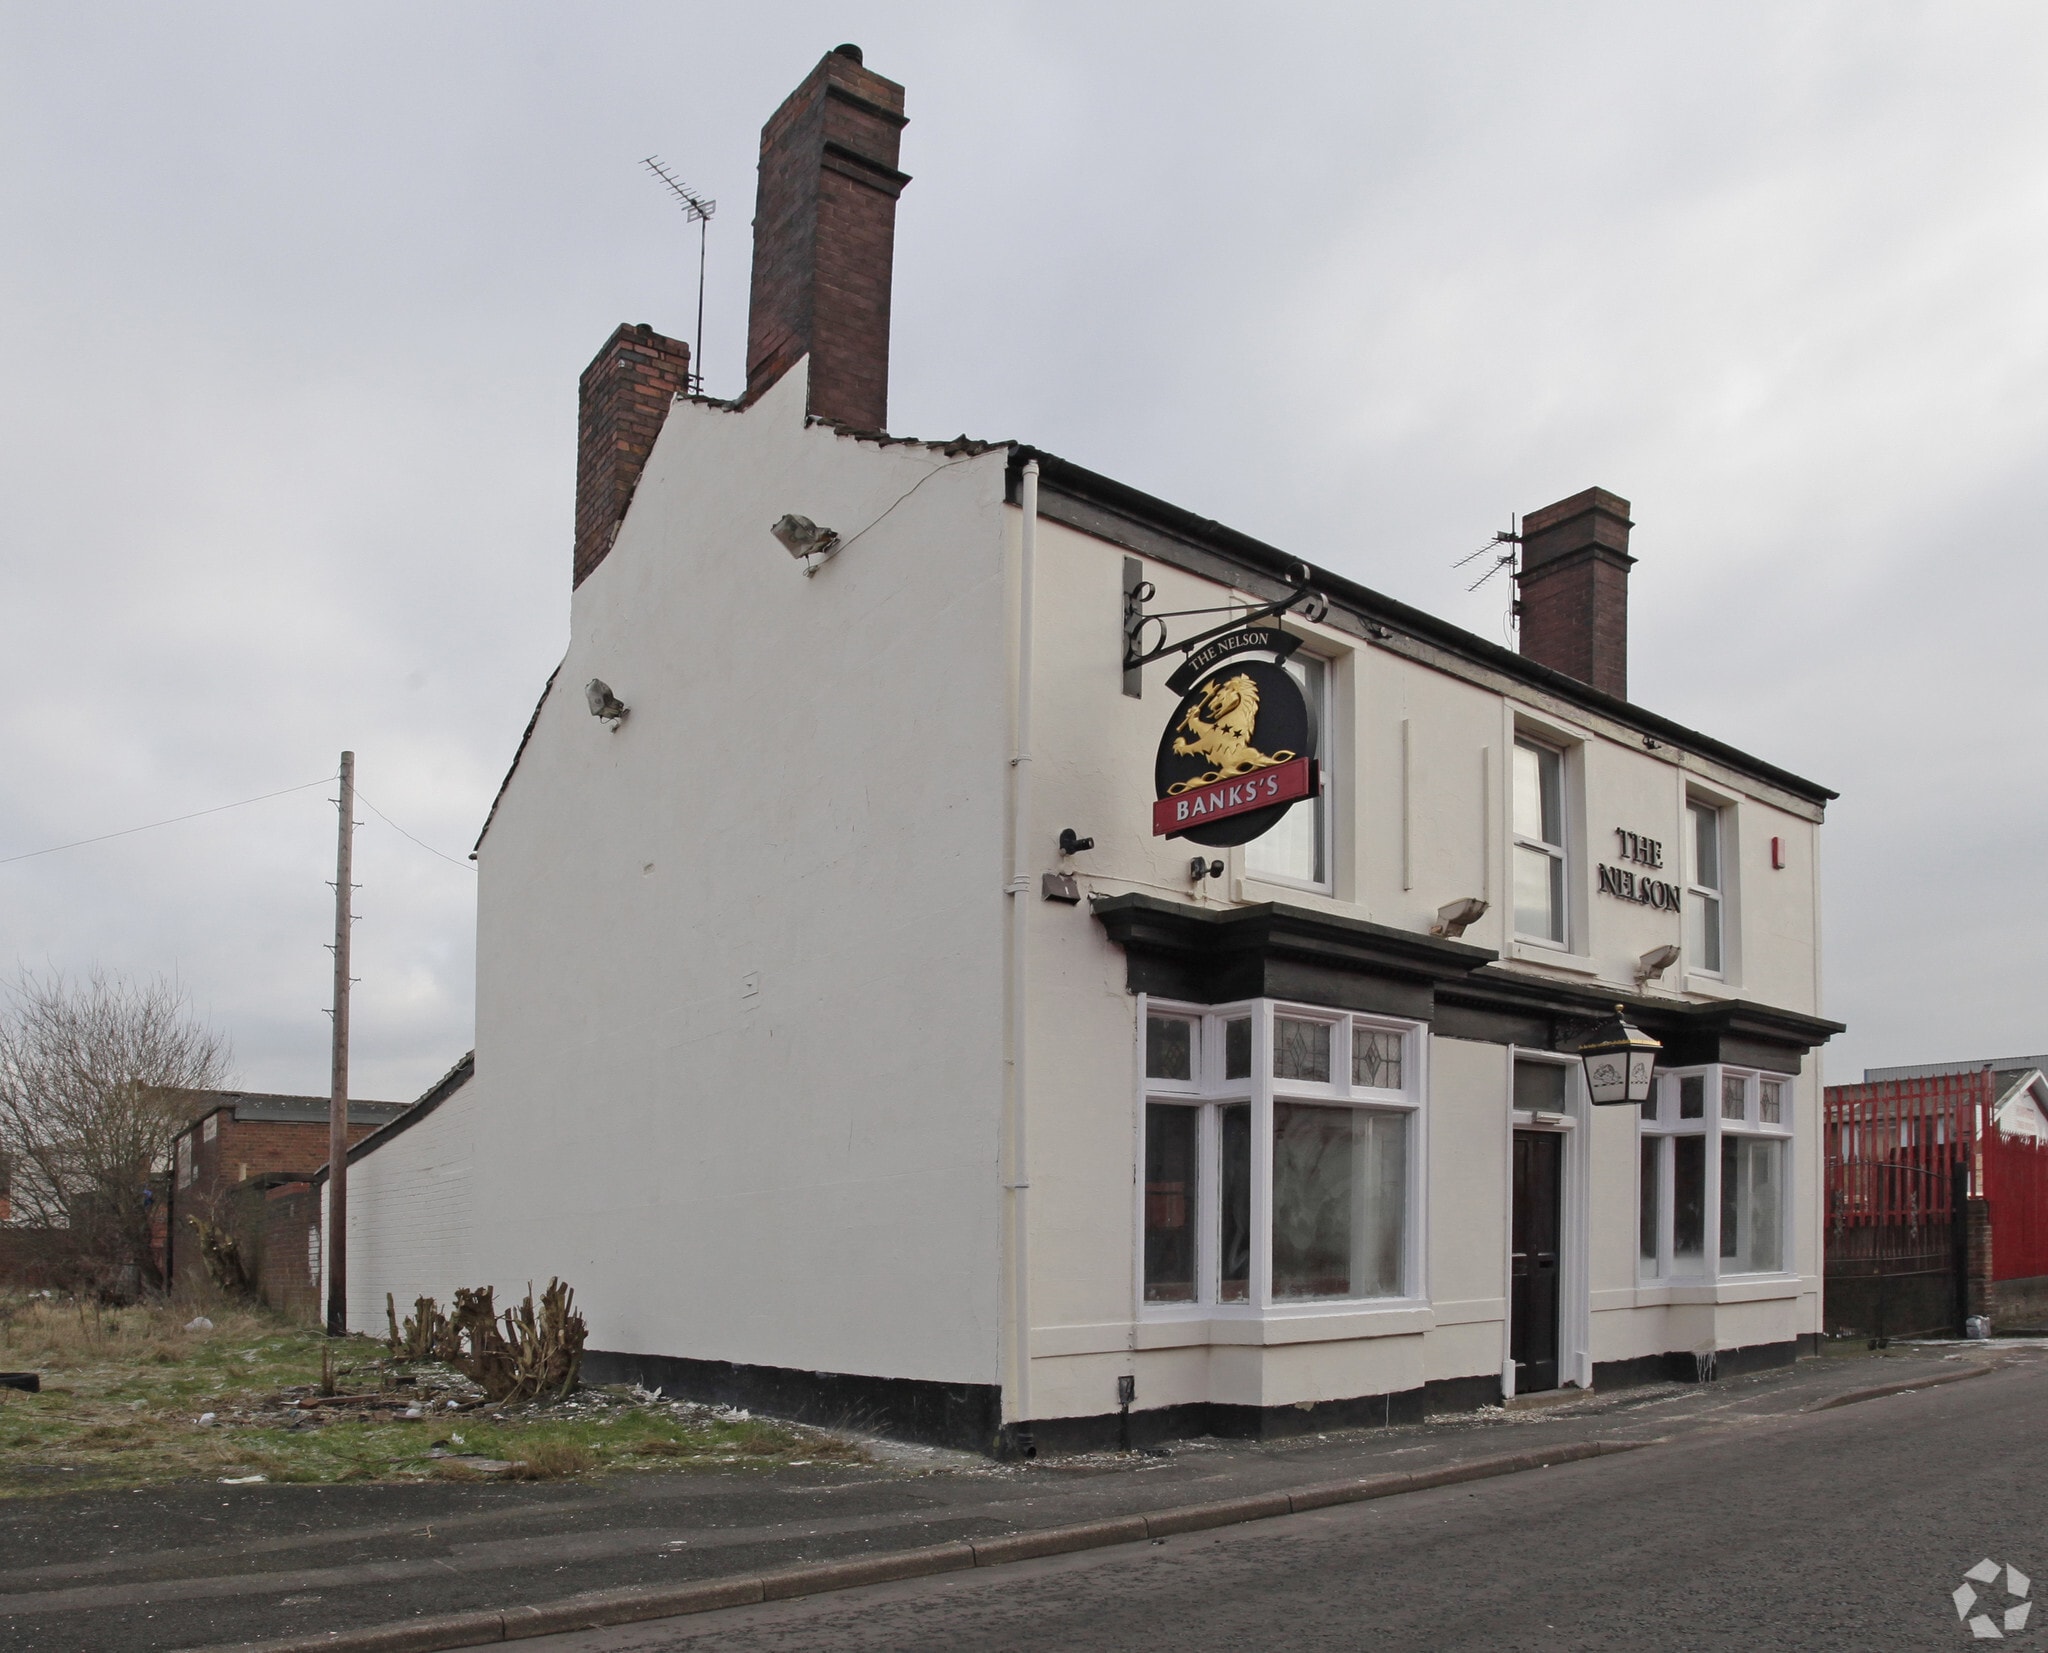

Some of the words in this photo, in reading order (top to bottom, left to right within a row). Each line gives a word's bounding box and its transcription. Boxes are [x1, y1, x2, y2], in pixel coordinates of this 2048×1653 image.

[1188, 646, 1217, 671] THE
[1217, 632, 1269, 654] NELSON
[1176, 774, 1279, 821] BANKS'S
[1615, 827, 1663, 869] THE
[1597, 863, 1681, 913] NELSON
